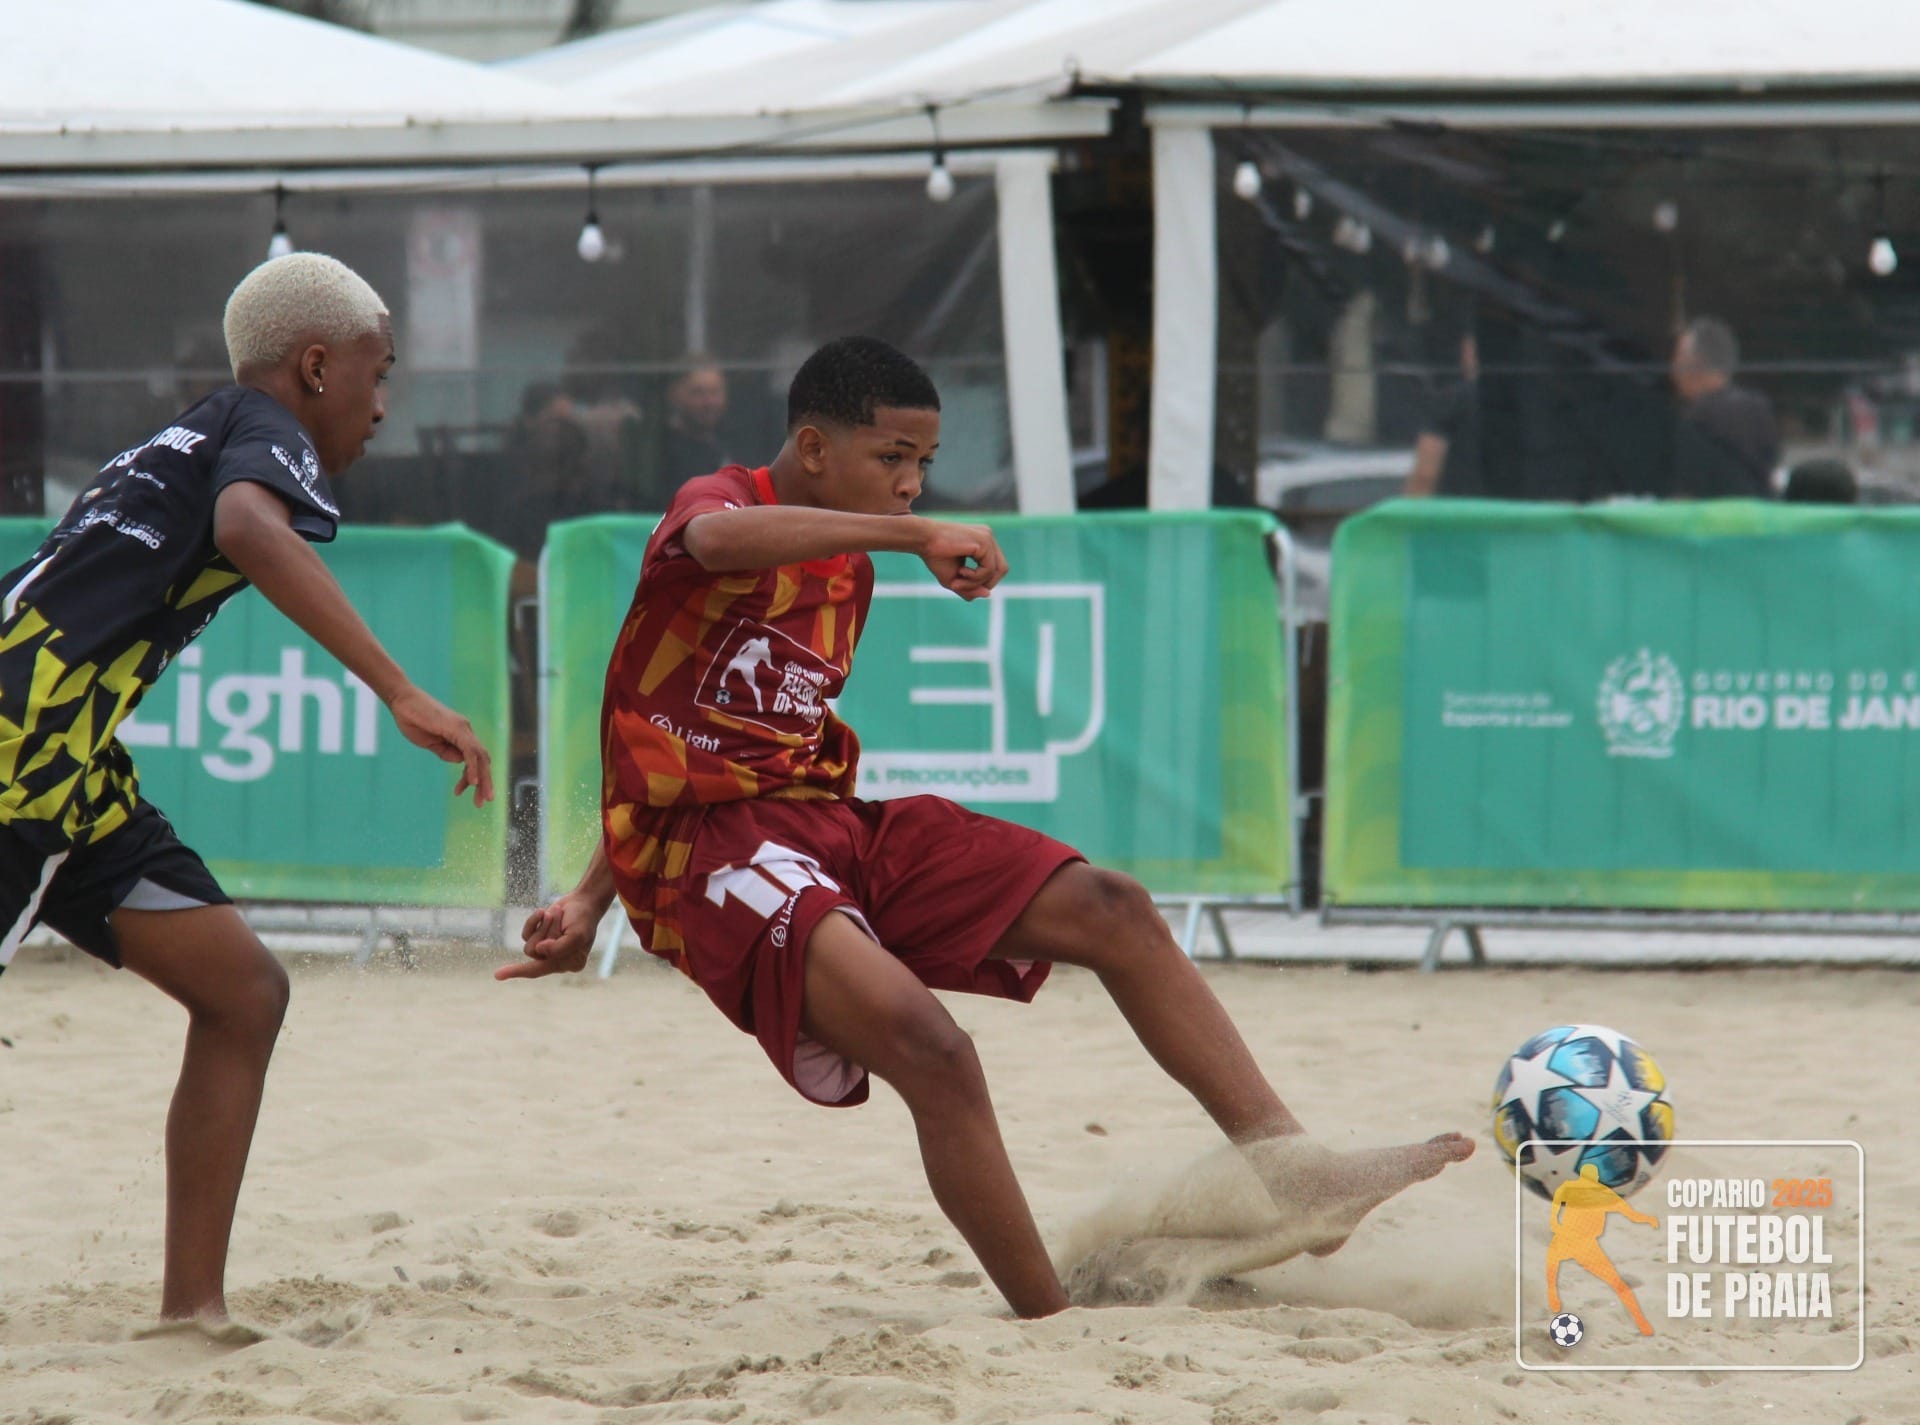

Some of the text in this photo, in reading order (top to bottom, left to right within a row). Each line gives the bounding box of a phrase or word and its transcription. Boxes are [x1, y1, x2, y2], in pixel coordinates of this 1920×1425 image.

[1692, 671, 1834, 692] GOVERNO
[1849, 671, 1889, 692] DO
[1692, 695, 1768, 731] RIO
[1774, 695, 1831, 731] DE
[677, 725, 720, 753] Light
[886, 763, 1030, 787] PRODUÇÕES
